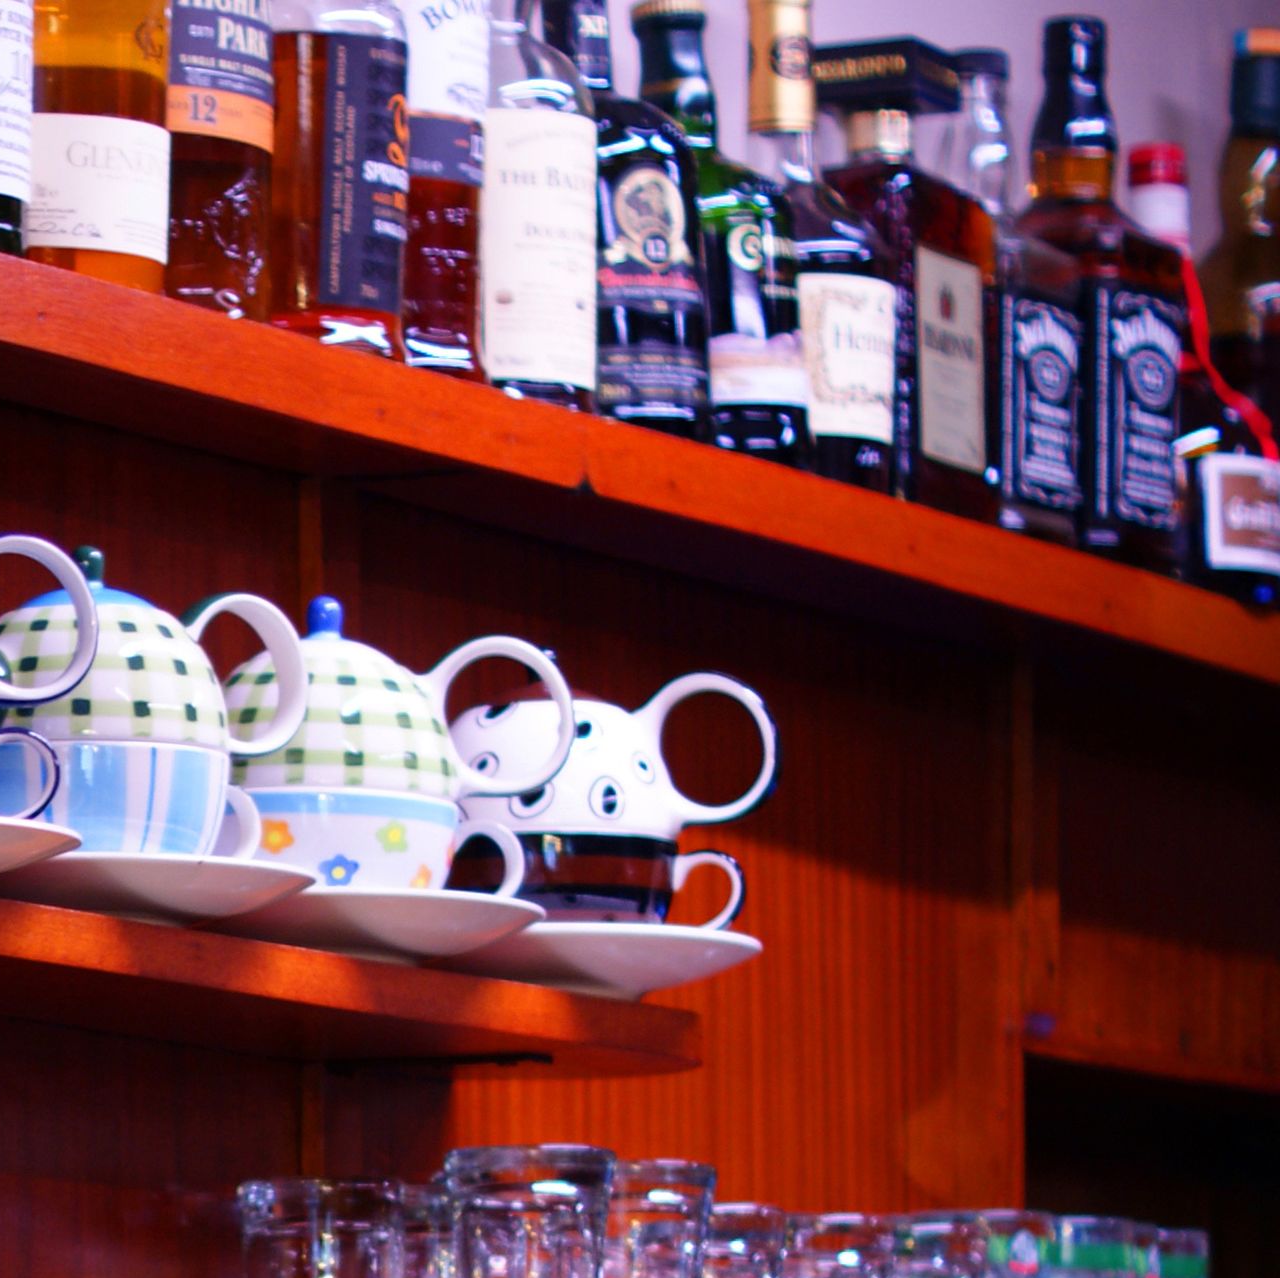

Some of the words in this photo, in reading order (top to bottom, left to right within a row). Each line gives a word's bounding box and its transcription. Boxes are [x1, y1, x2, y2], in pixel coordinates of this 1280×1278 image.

[217, 15, 269, 61] PARK
[188, 93, 217, 123] 12
[333, 136, 343, 165] MALT
